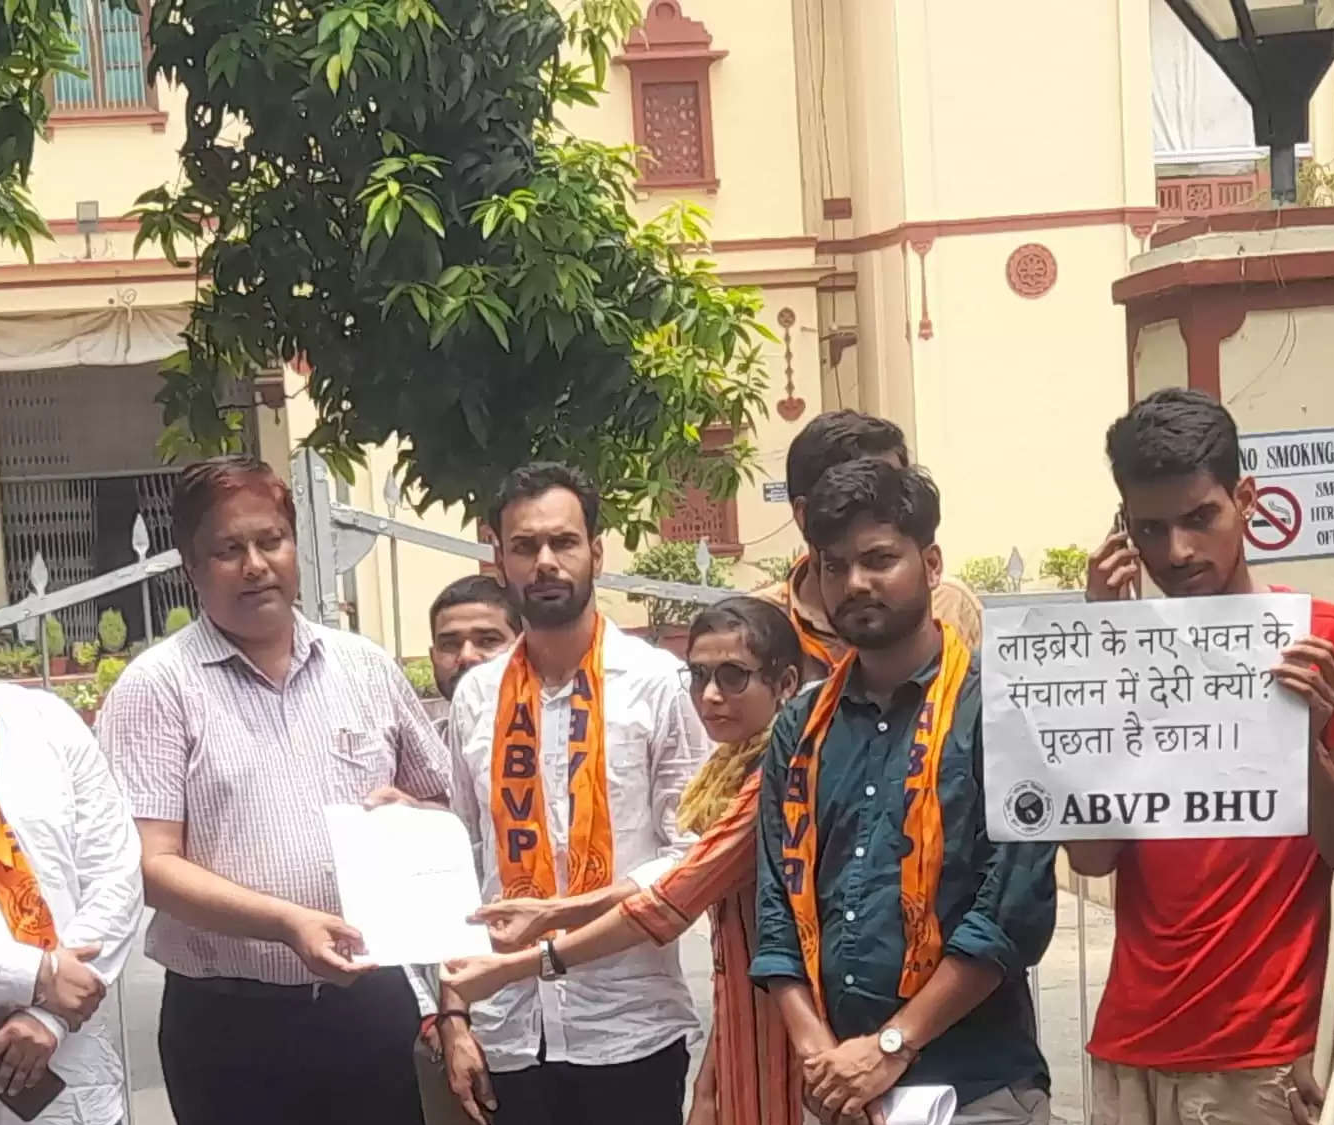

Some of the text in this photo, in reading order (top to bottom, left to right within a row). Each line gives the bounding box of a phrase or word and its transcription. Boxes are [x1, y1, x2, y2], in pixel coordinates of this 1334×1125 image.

[1239, 448, 1258, 471] NO
[1267, 441, 1334, 470] SMOKING
[997, 612, 1293, 667] लाइब्रेरी के नए भवन के
[1007, 663, 1275, 709] संचालन में देरी क्यों?
[1038, 727, 1114, 763] पूछता
[1122, 711, 1144, 757] है
[501, 702, 538, 864] ABVP
[1061, 791, 1171, 825] ABVP
[1183, 789, 1279, 824] BHU
